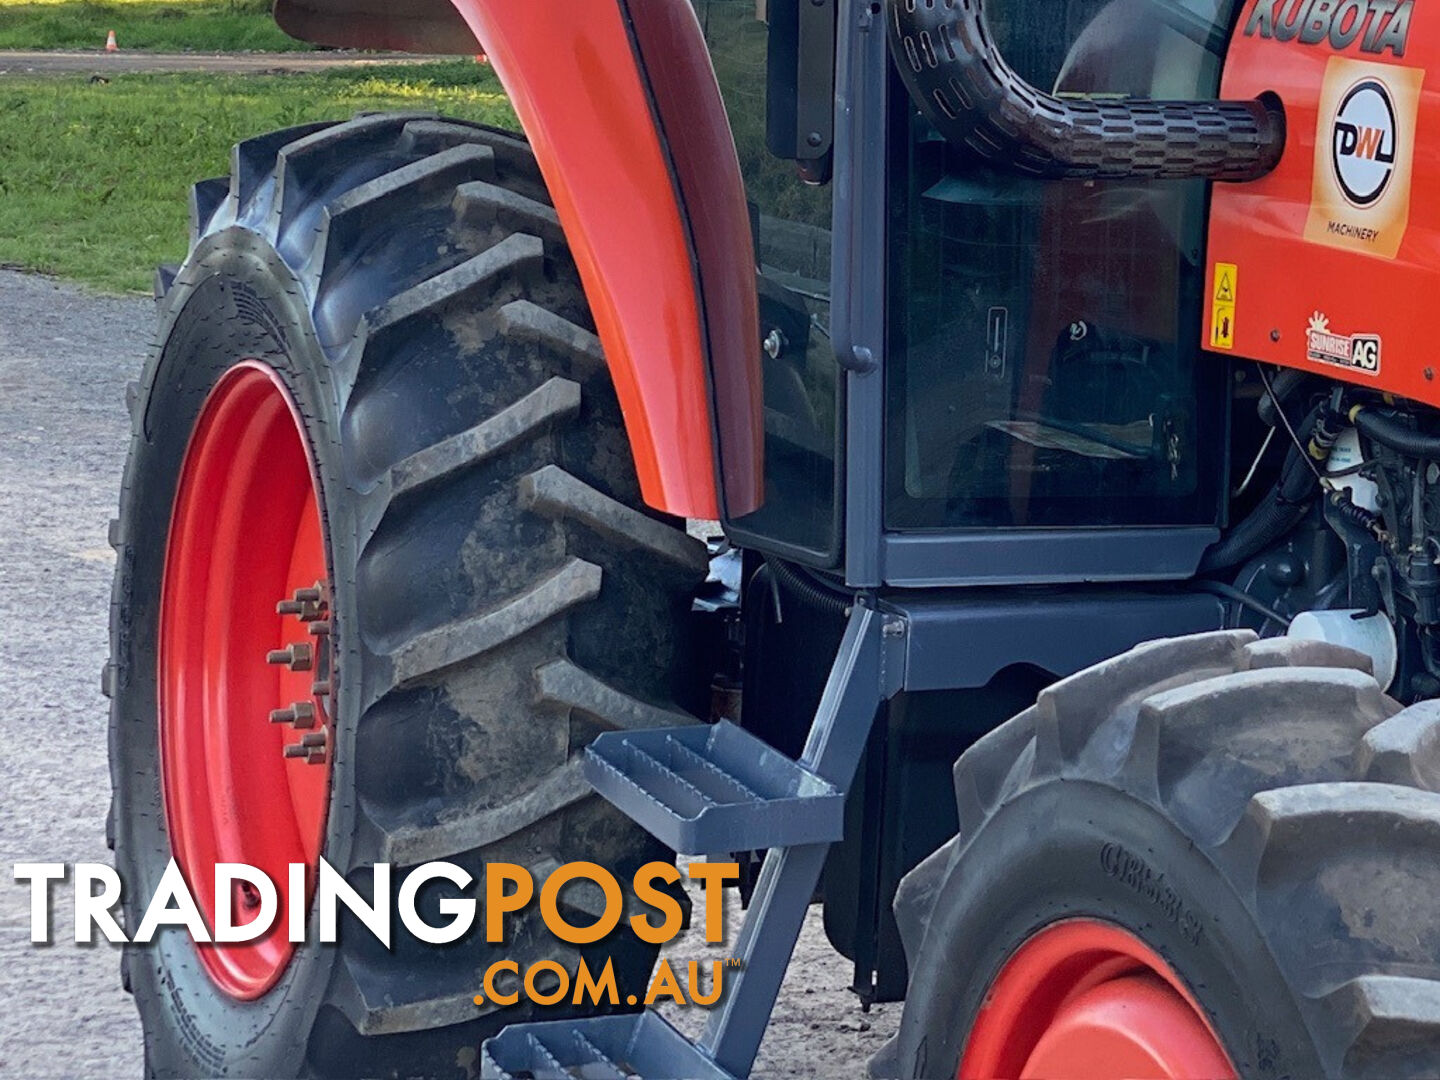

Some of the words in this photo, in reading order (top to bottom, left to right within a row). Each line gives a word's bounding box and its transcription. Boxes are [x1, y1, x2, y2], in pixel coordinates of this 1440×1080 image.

[1333, 121, 1395, 164] DWL
[1326, 221, 1379, 242] MACHINERY
[1310, 332, 1351, 357] SUNRISE
[1352, 340, 1377, 370] AG
